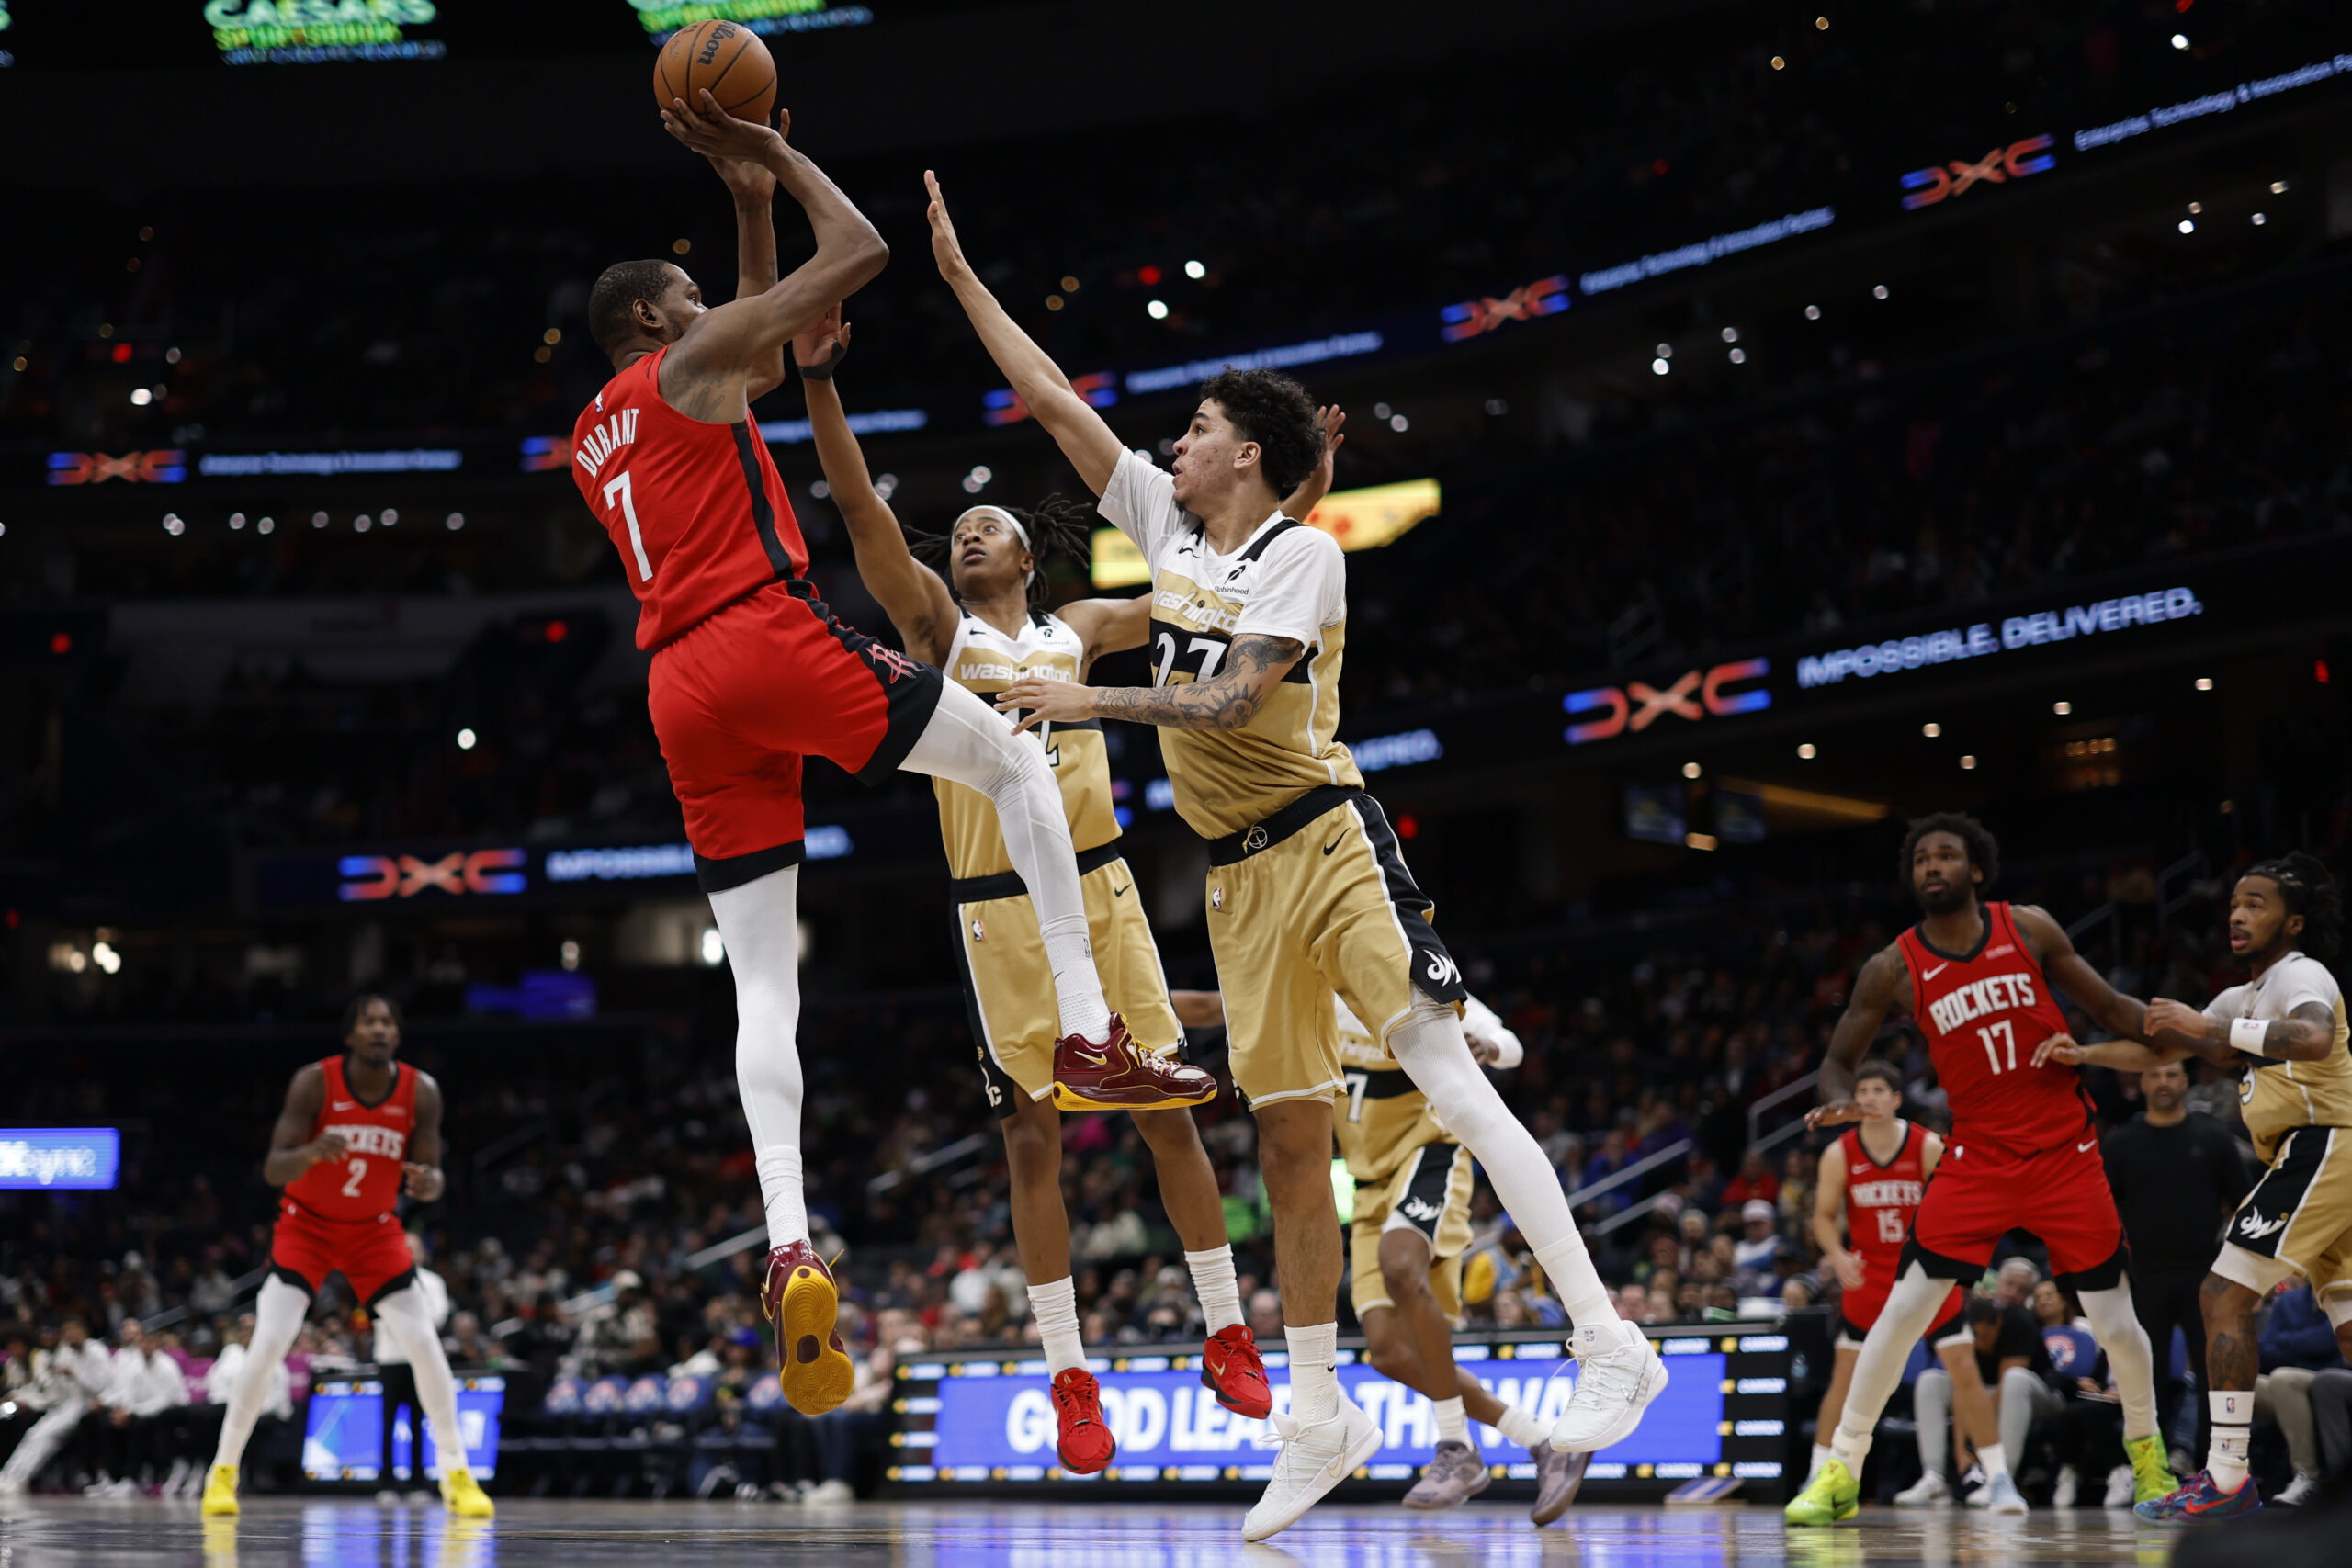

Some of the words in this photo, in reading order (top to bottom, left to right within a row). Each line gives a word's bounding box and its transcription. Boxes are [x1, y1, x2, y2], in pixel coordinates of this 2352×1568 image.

[575, 408, 639, 479] DURANT
[603, 469, 653, 582] 7
[2001, 586, 2204, 650] DELIVERED.
[1928, 972, 2037, 1036] ROCKETS
[1976, 1019, 2018, 1076] 17
[341, 1157, 368, 1198] 2
[1849, 1179, 1923, 1208] ROCKETS
[1876, 1207, 1905, 1244] 15
